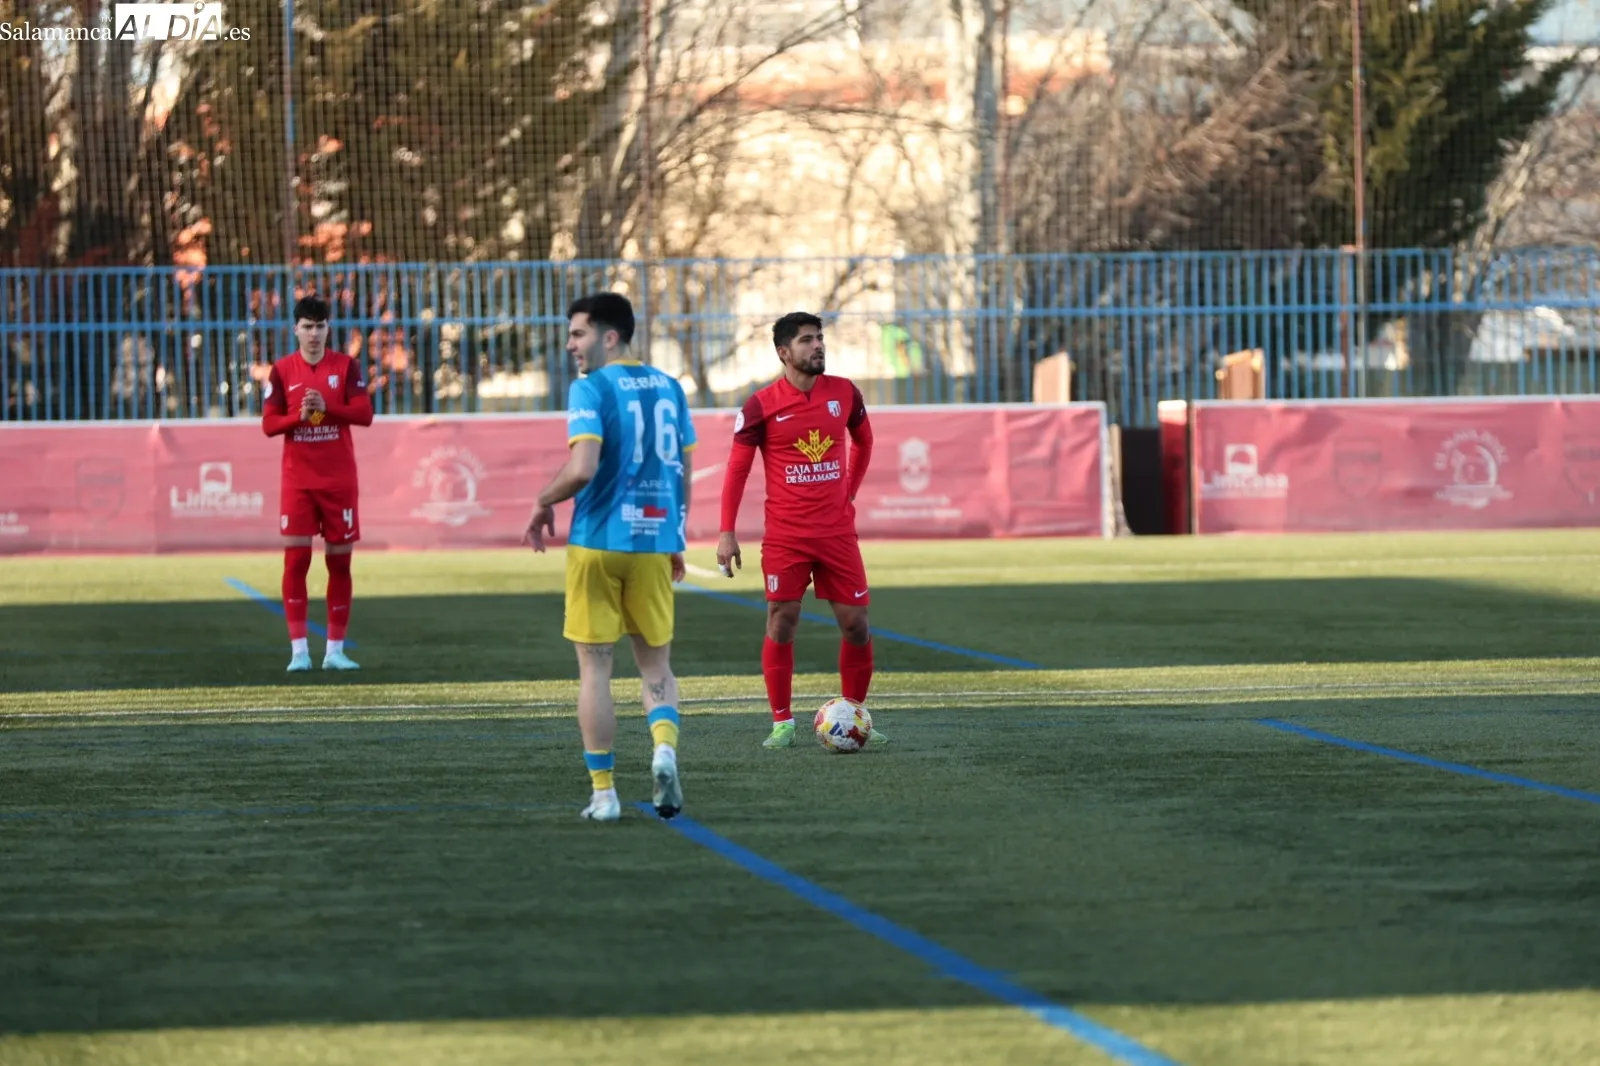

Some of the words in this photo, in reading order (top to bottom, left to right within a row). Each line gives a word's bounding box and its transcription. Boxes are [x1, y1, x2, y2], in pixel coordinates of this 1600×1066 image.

[627, 397, 678, 464] 16
[785, 464, 810, 476] CAJA
[813, 460, 840, 472] RURAL
[638, 479, 672, 489] AREA
[785, 475, 797, 483] DE
[342, 507, 353, 530] 4
